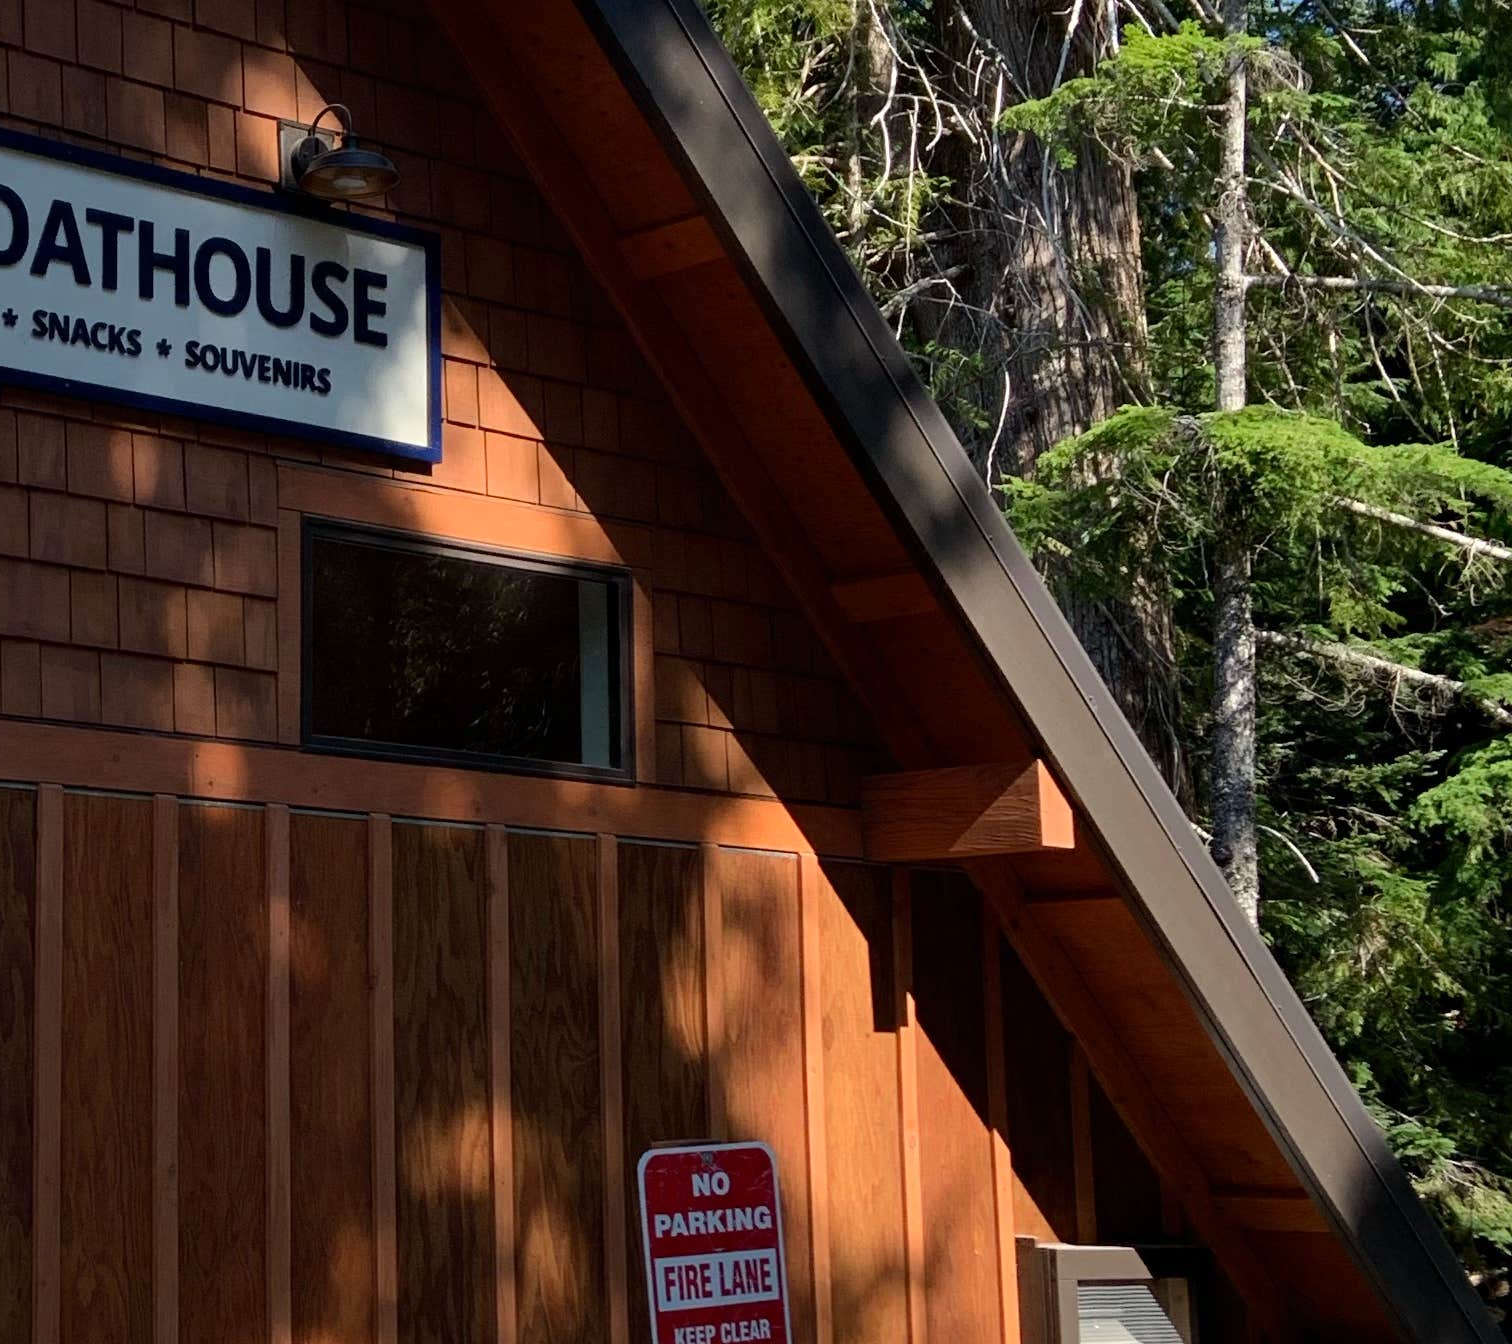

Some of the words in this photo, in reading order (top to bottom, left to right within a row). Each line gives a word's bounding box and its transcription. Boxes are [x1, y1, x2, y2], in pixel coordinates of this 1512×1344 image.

[31, 309, 143, 358] SNACKS
[184, 339, 332, 397] SOUVENIRS
[691, 1171, 731, 1197] NO
[654, 1205, 773, 1238] PARKING
[663, 1262, 713, 1303] FIRE
[718, 1257, 773, 1297] LANE
[720, 1318, 771, 1344] CLEAR
